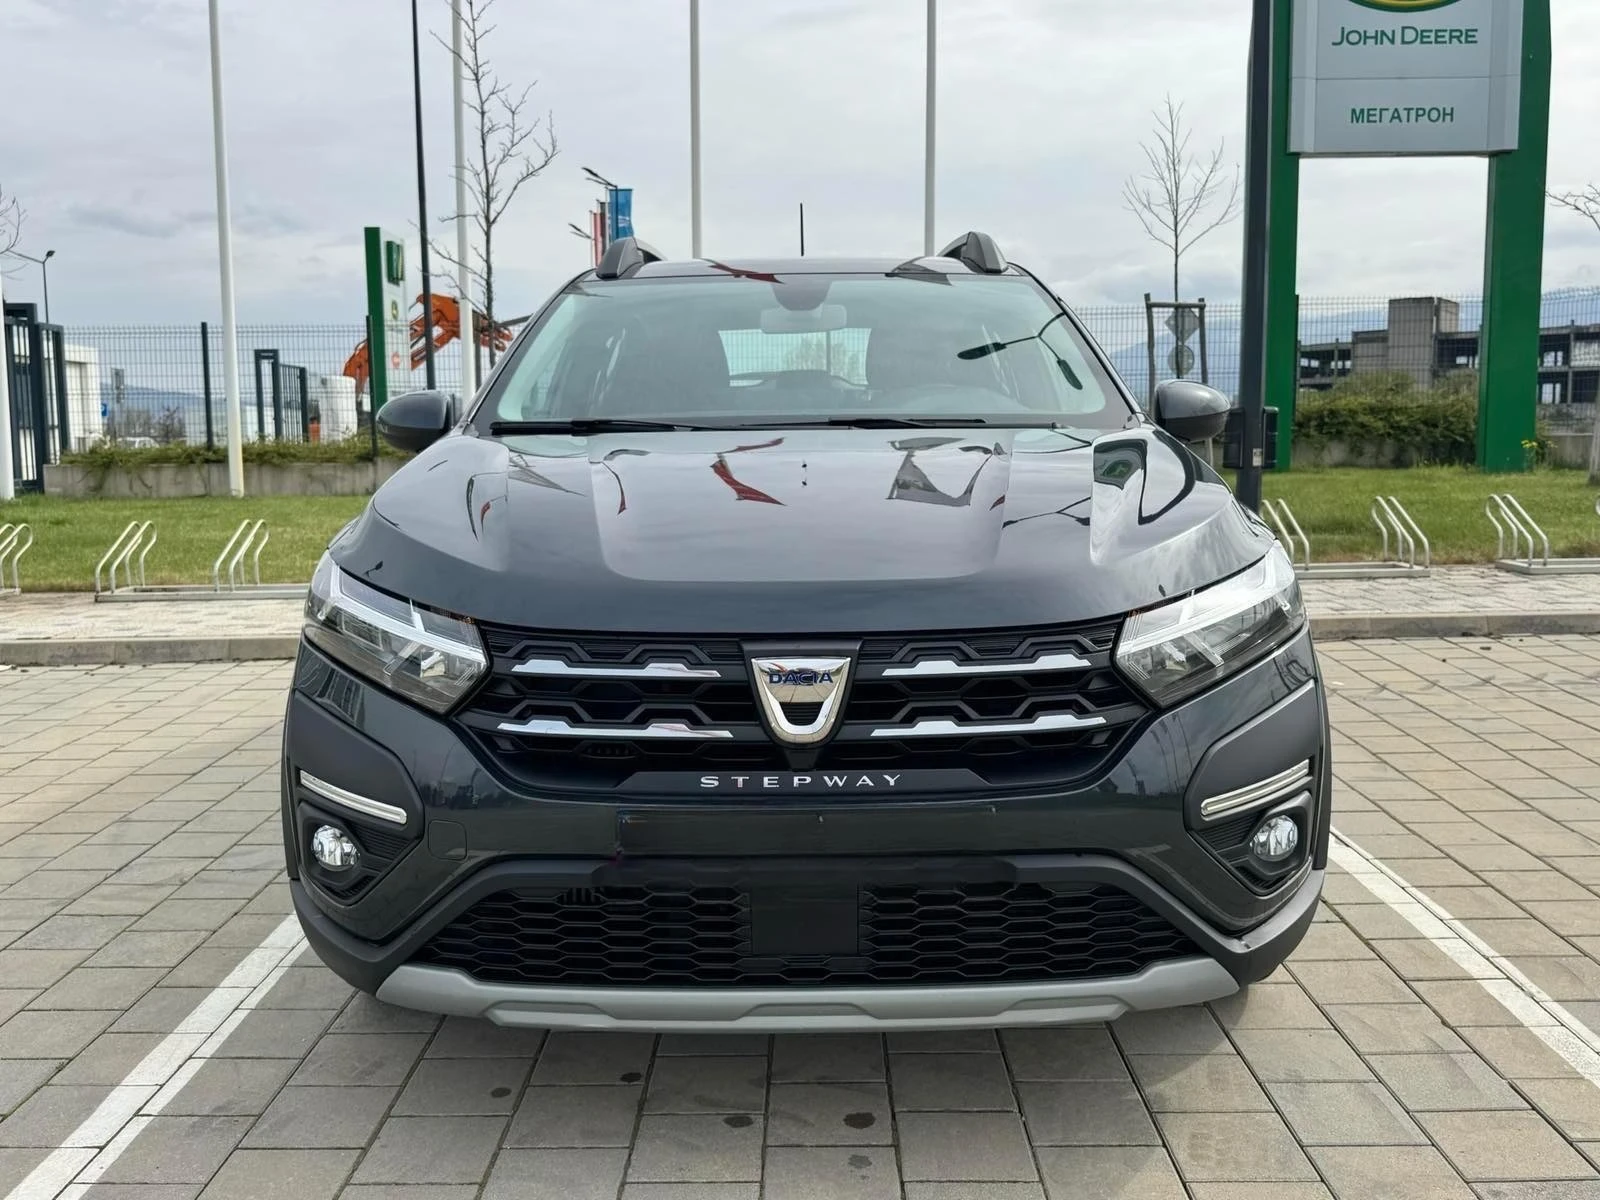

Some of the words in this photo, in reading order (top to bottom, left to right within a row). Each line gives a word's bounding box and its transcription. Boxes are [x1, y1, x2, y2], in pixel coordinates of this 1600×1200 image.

[1332, 26, 1395, 46] JOHN
[1400, 26, 1478, 45] DEERE
[1350, 107, 1454, 124] МЕГАТРОН
[768, 671, 834, 685] DACIA
[700, 774, 901, 788] STEPWAY
